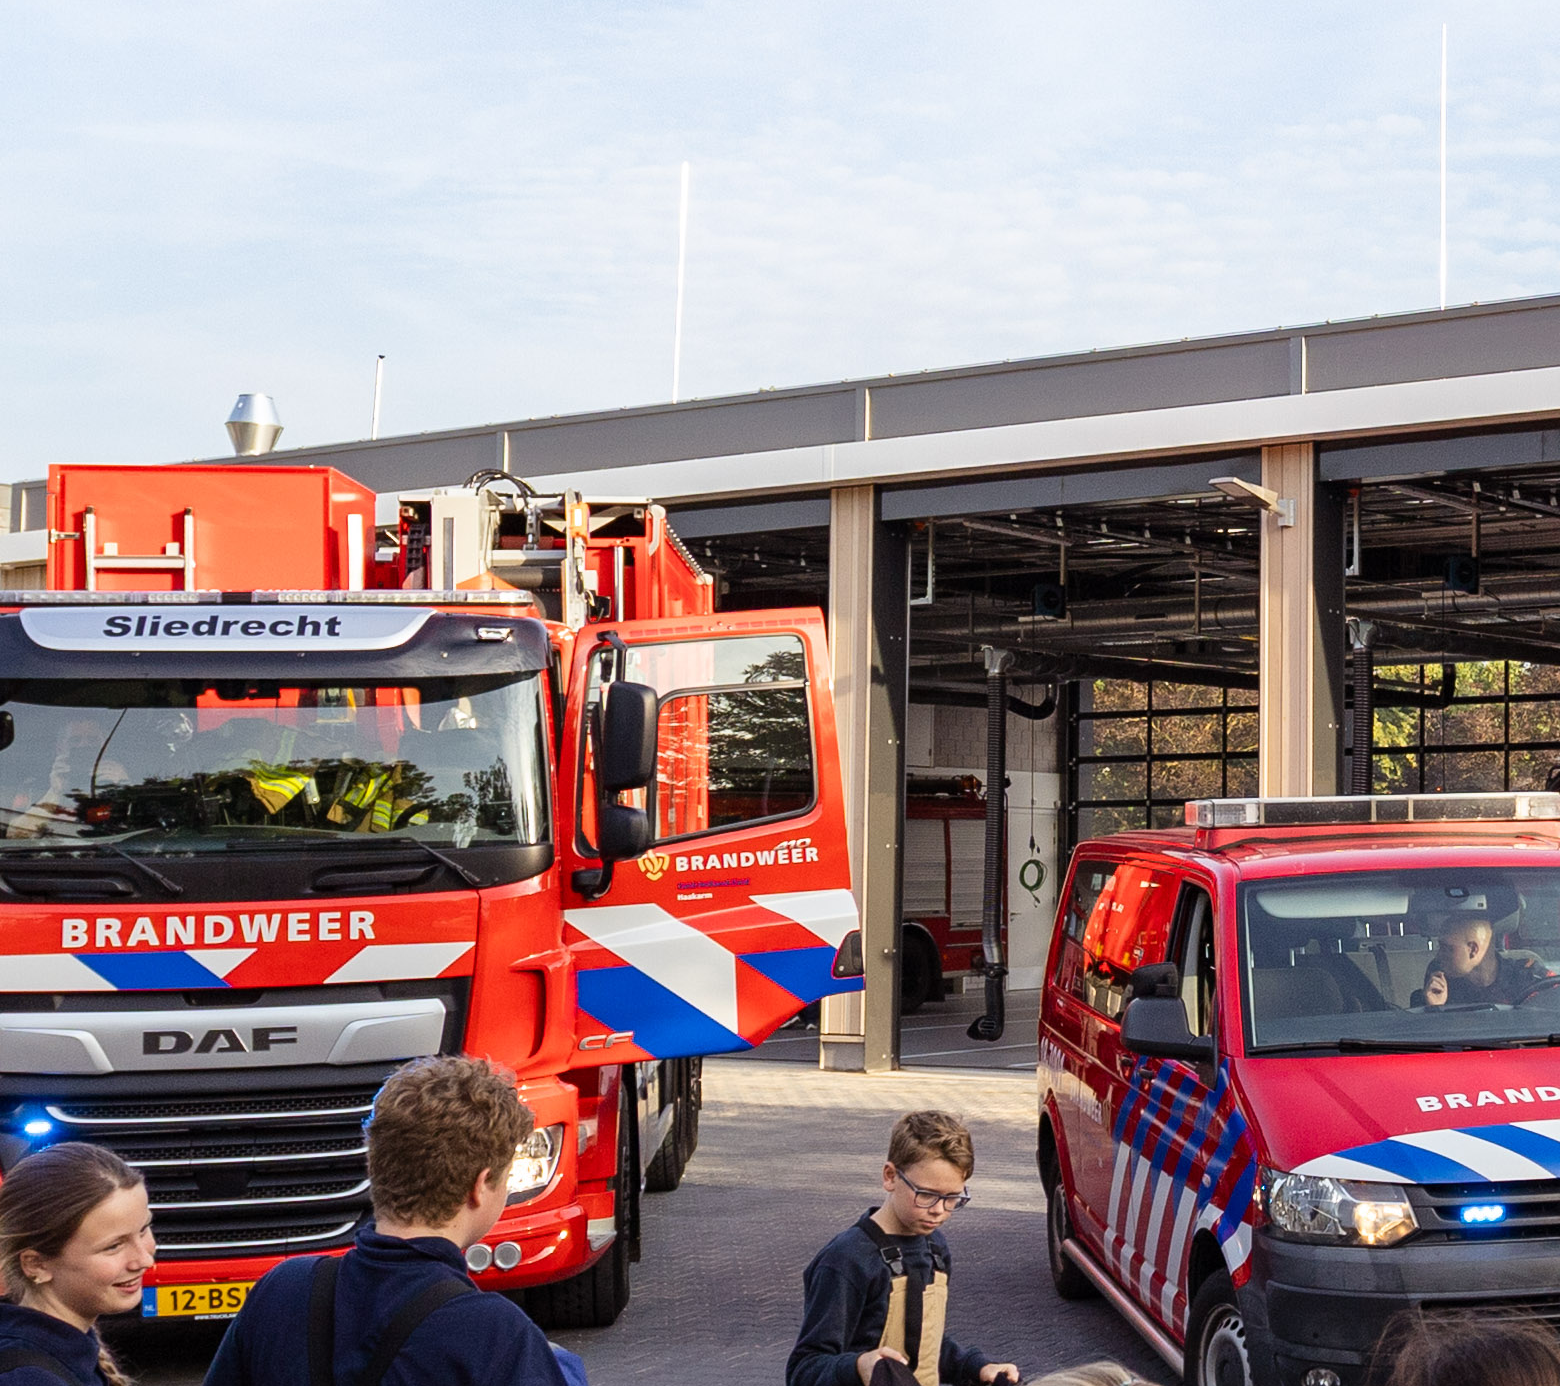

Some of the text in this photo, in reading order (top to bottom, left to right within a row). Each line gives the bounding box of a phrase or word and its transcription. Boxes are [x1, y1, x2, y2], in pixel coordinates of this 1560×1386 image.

[103, 615, 341, 637] Sliedrecht
[675, 847, 819, 872] BRANDWEER
[61, 911, 375, 949] BRANDWEER
[142, 1026, 298, 1055] DAF
[578, 1031, 634, 1051] CF
[170, 1287, 251, 1311] 12-BS
